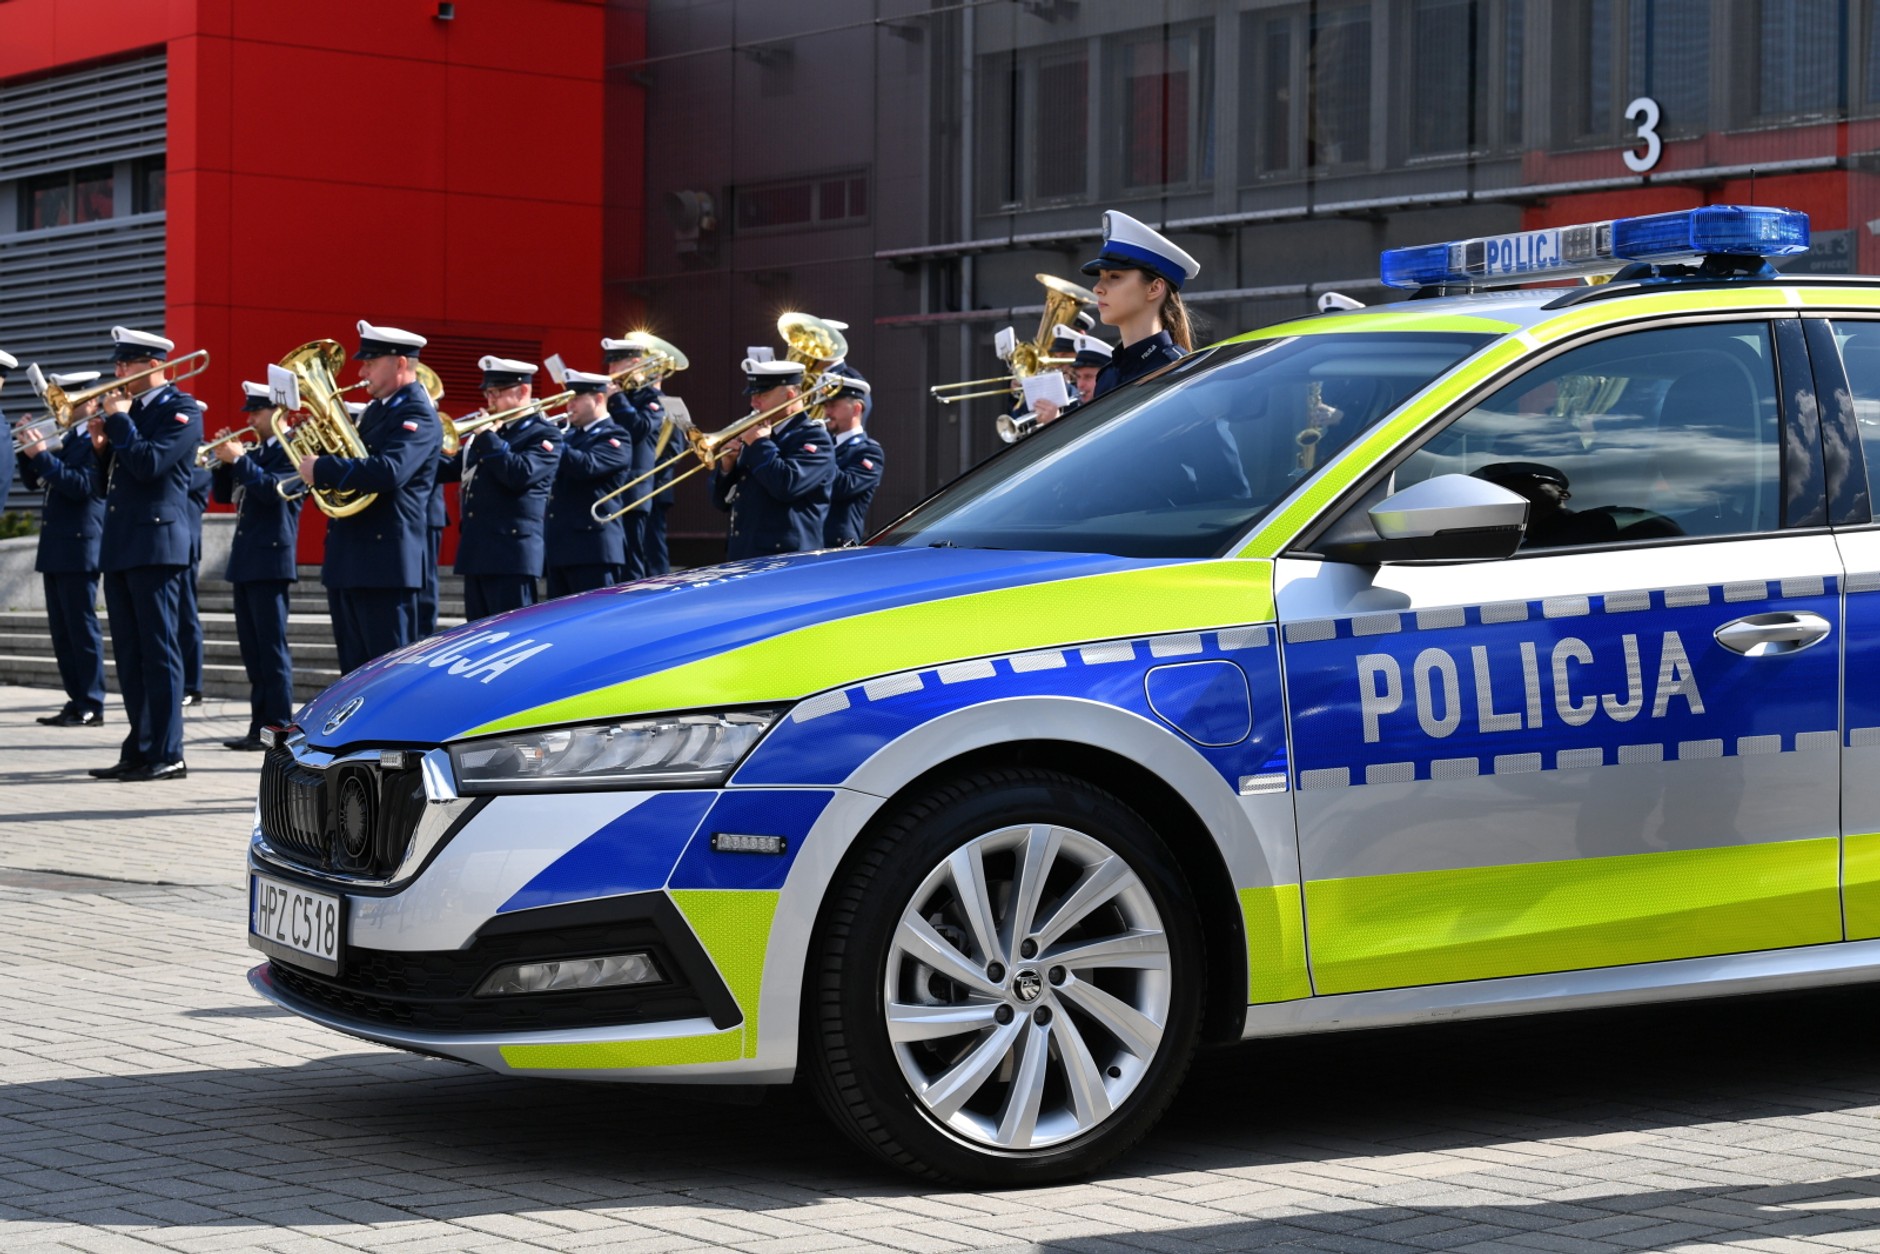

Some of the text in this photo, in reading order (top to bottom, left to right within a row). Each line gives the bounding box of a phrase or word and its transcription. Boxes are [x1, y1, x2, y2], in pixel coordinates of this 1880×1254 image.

[1622, 97, 1661, 172] 3
[1357, 630, 1706, 744] POLICJA
[259, 882, 336, 957] HPZ C518
